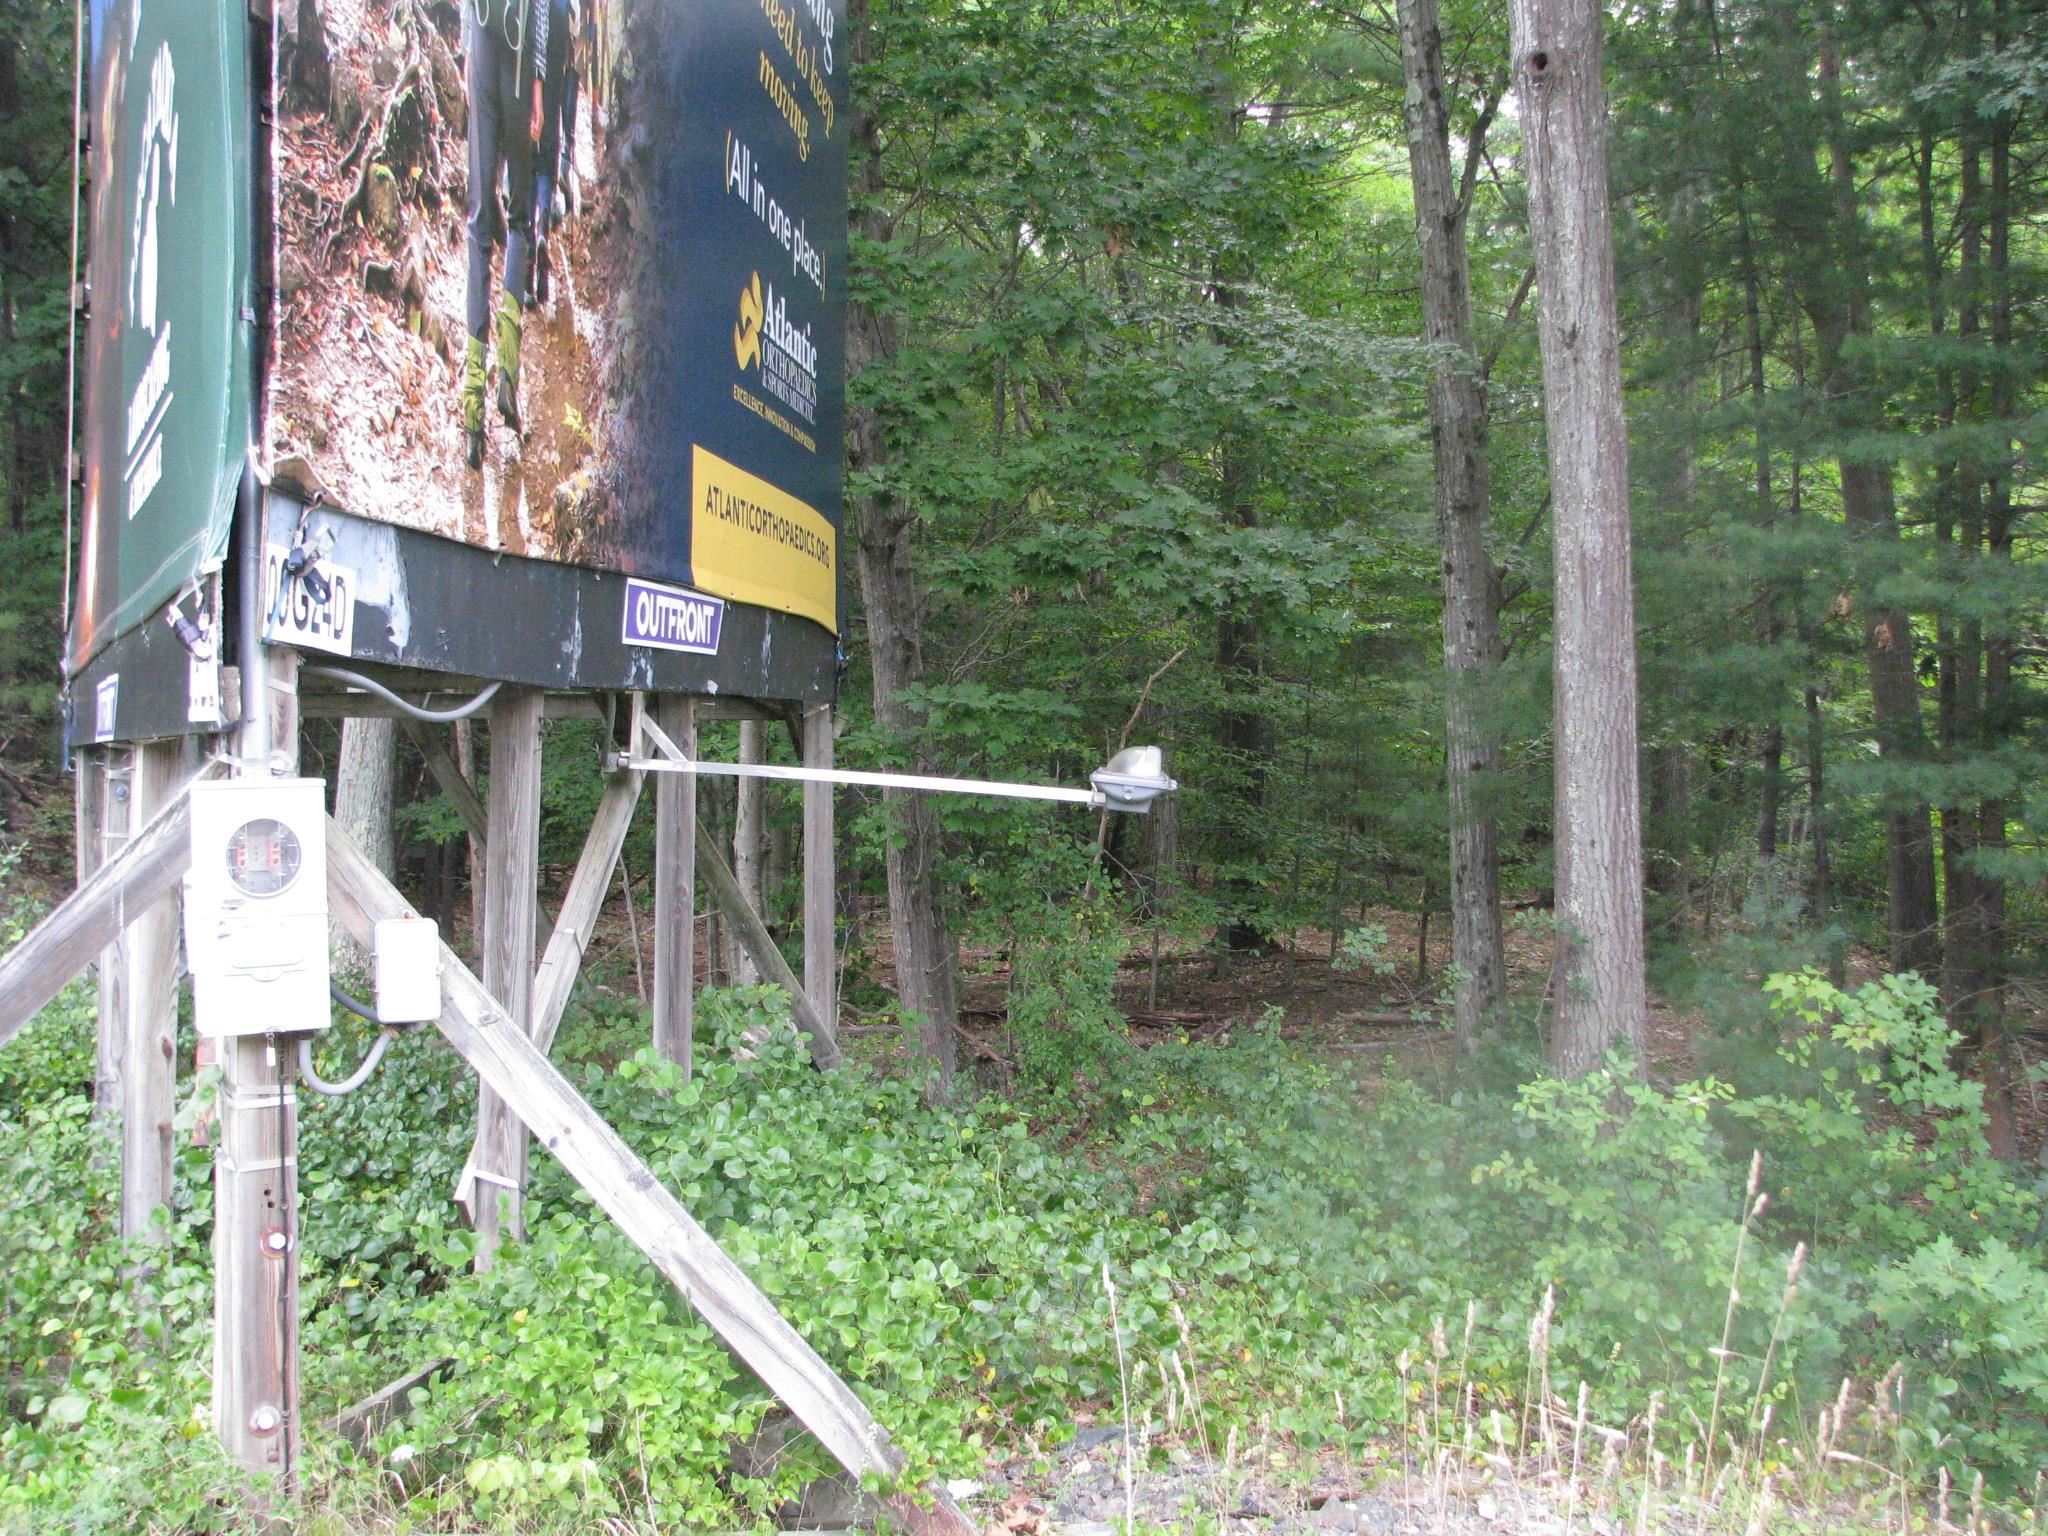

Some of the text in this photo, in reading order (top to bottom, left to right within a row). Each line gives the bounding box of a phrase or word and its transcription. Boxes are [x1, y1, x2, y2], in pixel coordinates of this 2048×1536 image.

[796, 29, 808, 79] to
[811, 46, 834, 140] keep
[726, 129, 750, 204] (All
[753, 162, 765, 222] in
[769, 198, 791, 251] one
[762, 338, 817, 407] ORTHOPAEDICS
[763, 282, 817, 379] Atlantic
[705, 484, 830, 569] ATLANTICORTHOPAEDICS.ORG
[636, 591, 715, 645] OUTFRONT
